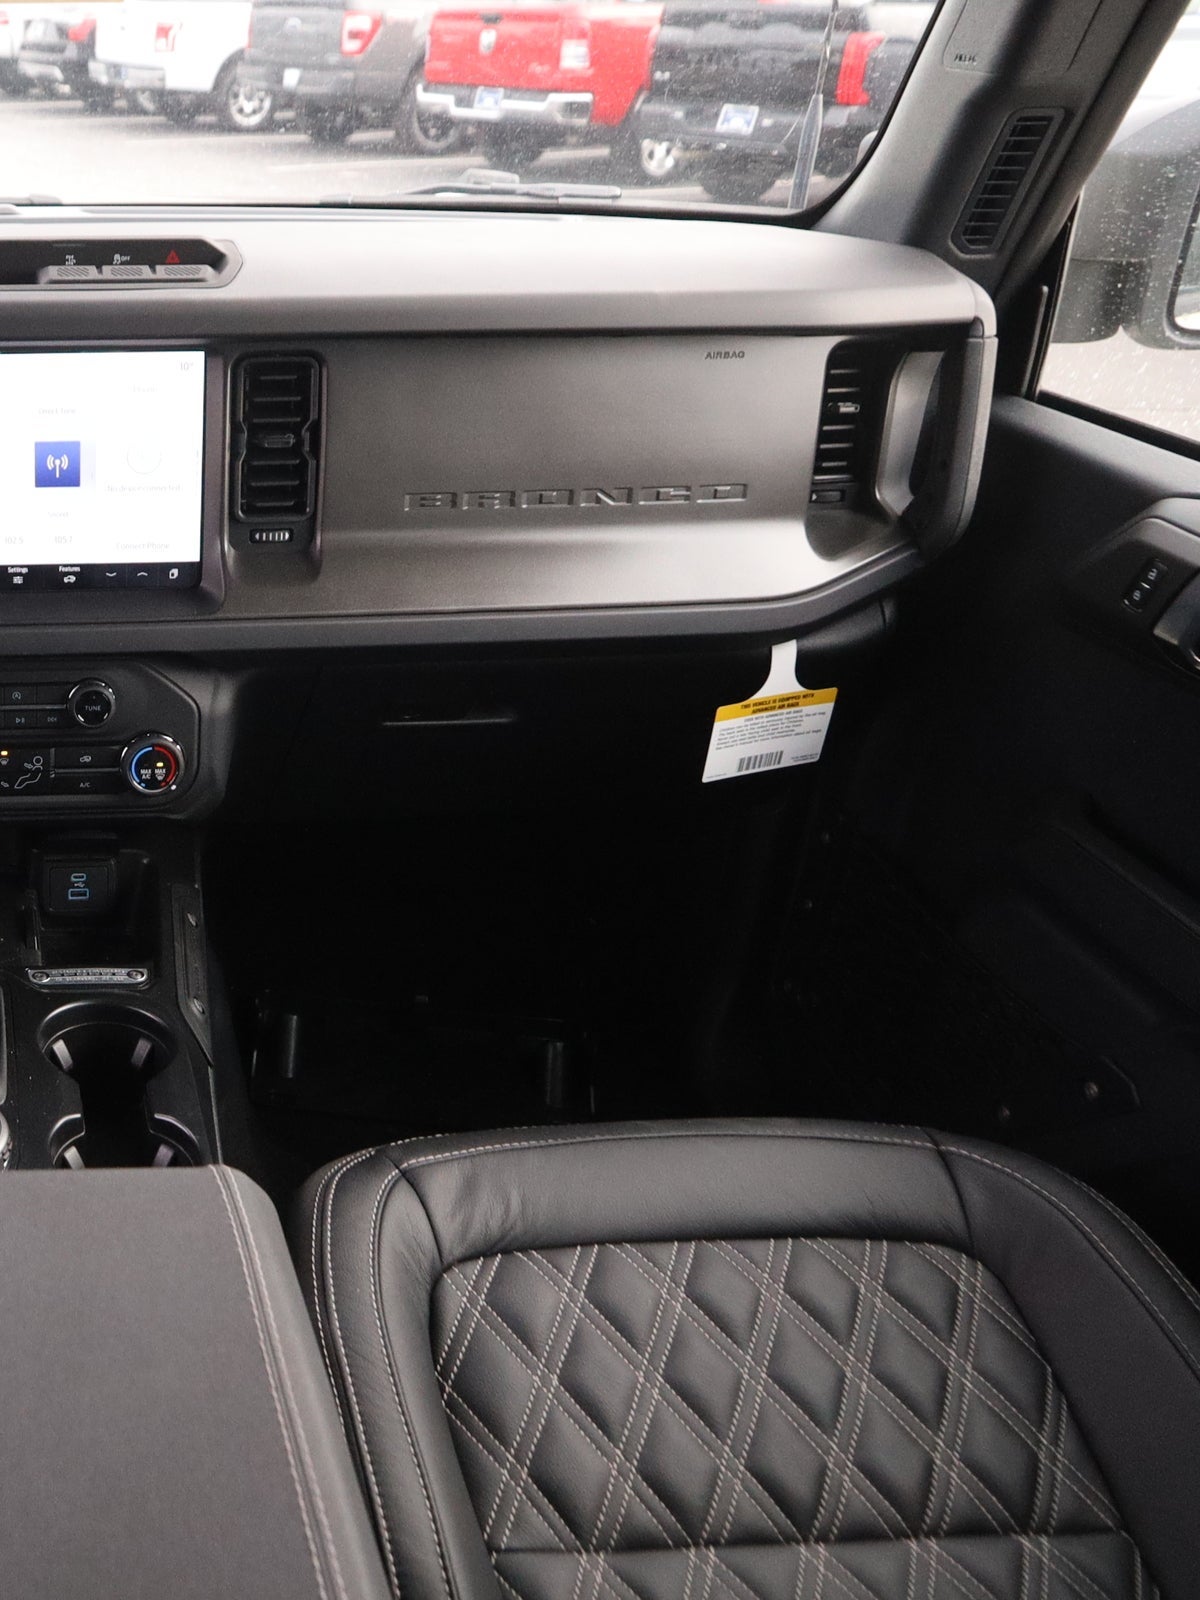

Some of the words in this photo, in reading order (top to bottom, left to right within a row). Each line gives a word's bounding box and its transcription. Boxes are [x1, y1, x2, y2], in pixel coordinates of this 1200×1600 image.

[704, 351, 745, 360] AIRBAG
[404, 483, 748, 511] BRONCO
[8, 566, 28, 575] Settings
[59, 565, 80, 573] Features
